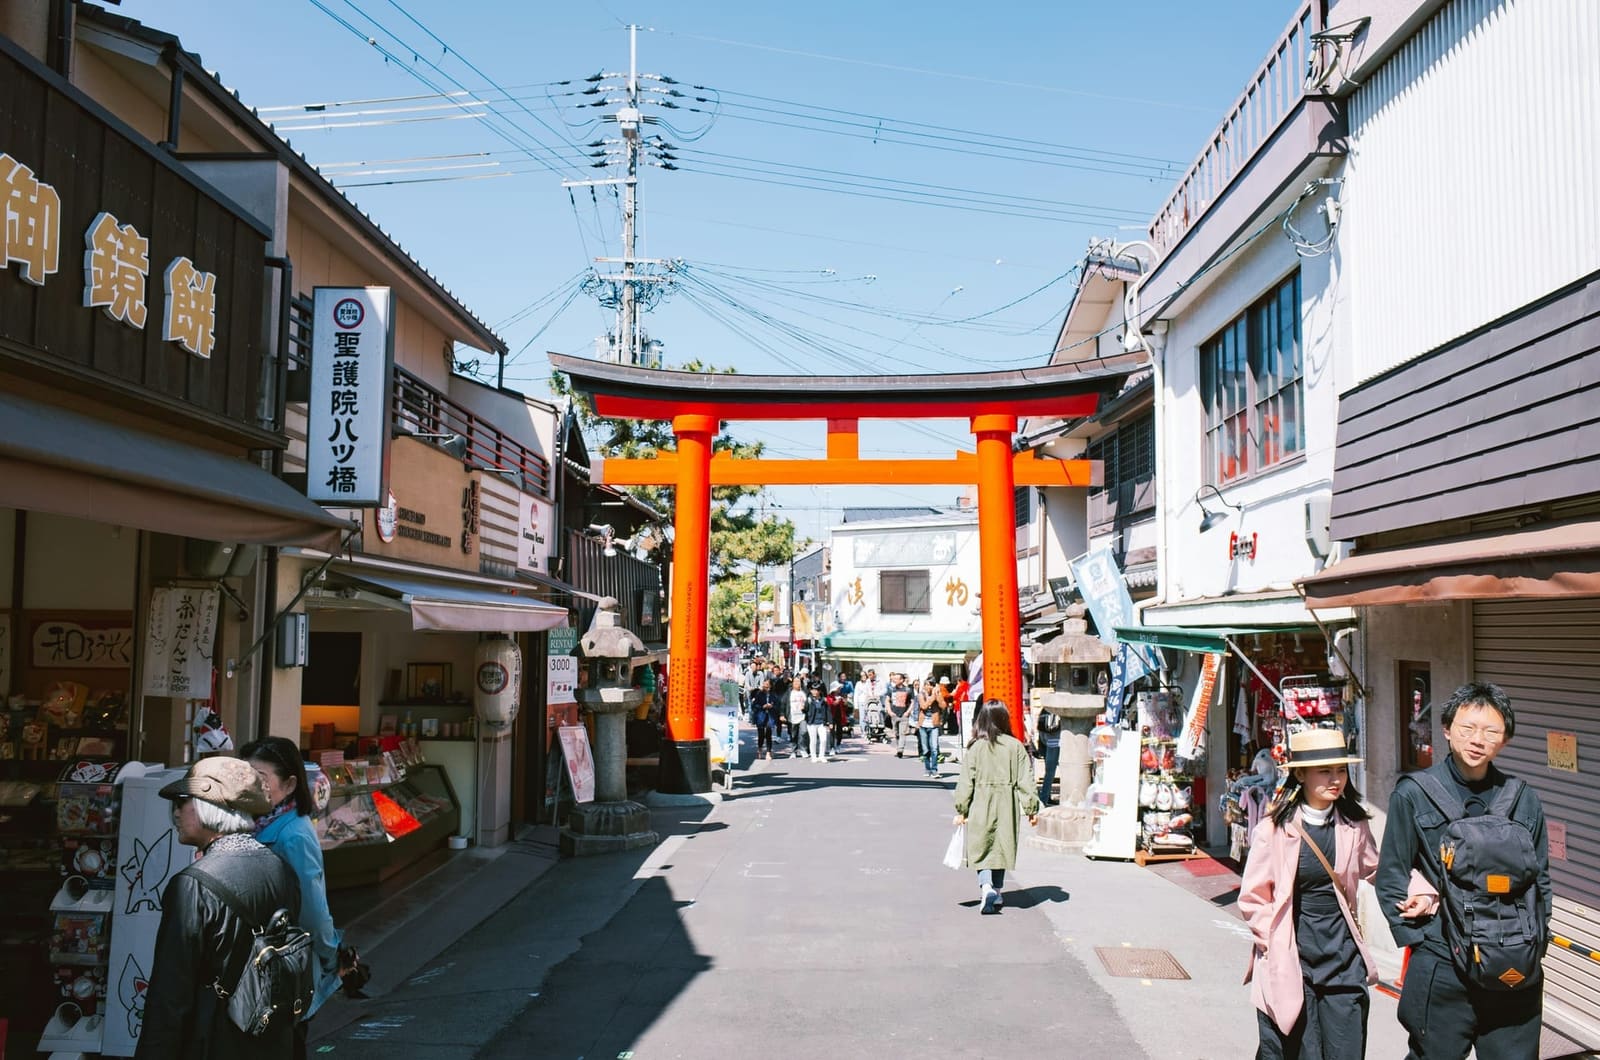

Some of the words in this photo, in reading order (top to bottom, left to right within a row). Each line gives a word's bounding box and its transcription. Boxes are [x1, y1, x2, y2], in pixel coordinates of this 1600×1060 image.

[326, 331, 362, 493] 聖護院八ツ橋
[550, 638, 574, 649] RENTAL
[551, 658, 570, 671] 3000
